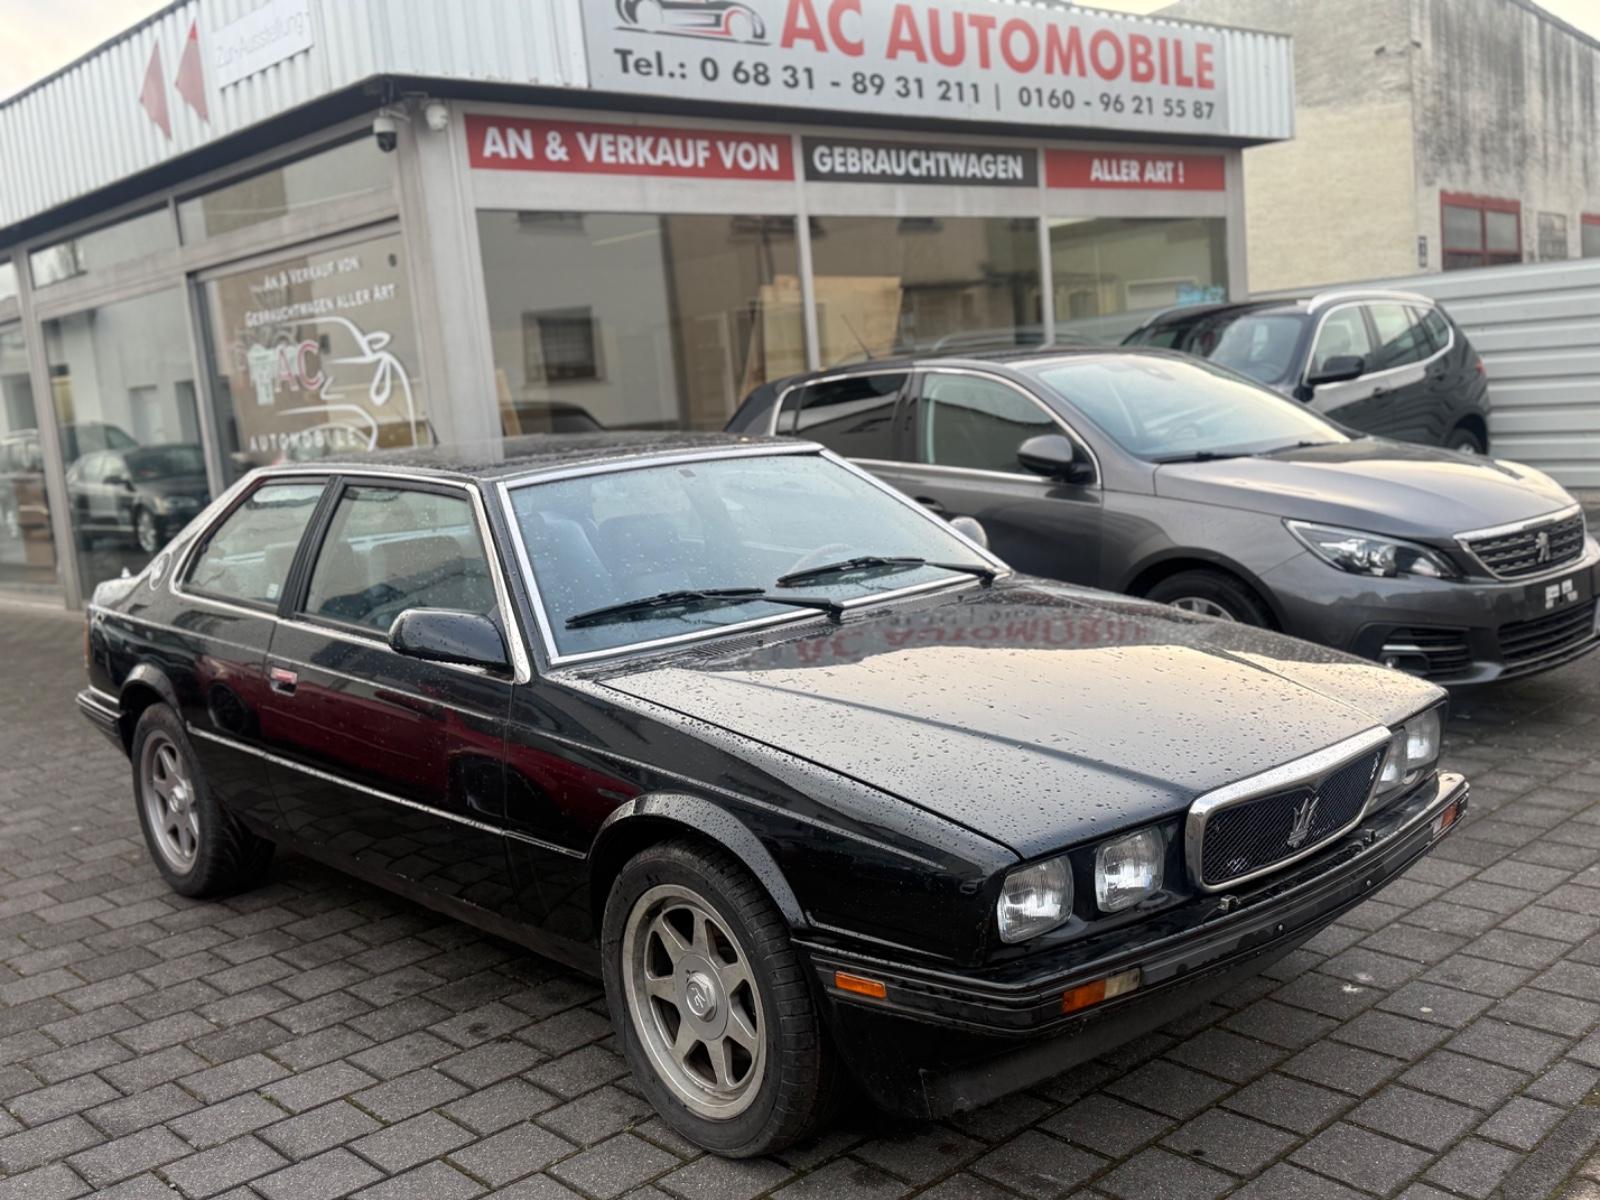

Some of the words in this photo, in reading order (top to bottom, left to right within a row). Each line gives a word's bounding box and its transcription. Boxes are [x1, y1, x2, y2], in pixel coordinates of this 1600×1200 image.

[780, 0, 865, 57] AC
[886, 3, 1215, 90] AUTOMOBILE
[614, 48, 688, 80] Tel.:
[700, 57, 719, 82] 0
[732, 60, 771, 87] 68
[782, 65, 815, 91] 31
[852, 72, 885, 96] 89
[895, 76, 925, 99] 31
[936, 80, 981, 103] 211
[1018, 87, 1075, 110] 0160
[1099, 92, 1125, 114] 96
[1132, 95, 1154, 116] 21
[1163, 97, 1187, 119] 55
[1193, 101, 1215, 120] 87
[483, 127, 534, 160] AN
[545, 131, 570, 162] &
[576, 132, 711, 168] VERKAUF
[717, 140, 780, 171] VON
[813, 145, 1024, 180] GEBRAUCHTWAGEN
[1090, 158, 1140, 182] ALLER
[1144, 160, 1175, 183] ART
[245, 301, 335, 327] GEBRAUCHTWAGEN
[336, 289, 370, 308] ALLER
[373, 283, 395, 300] ART
[275, 340, 324, 394] AC
